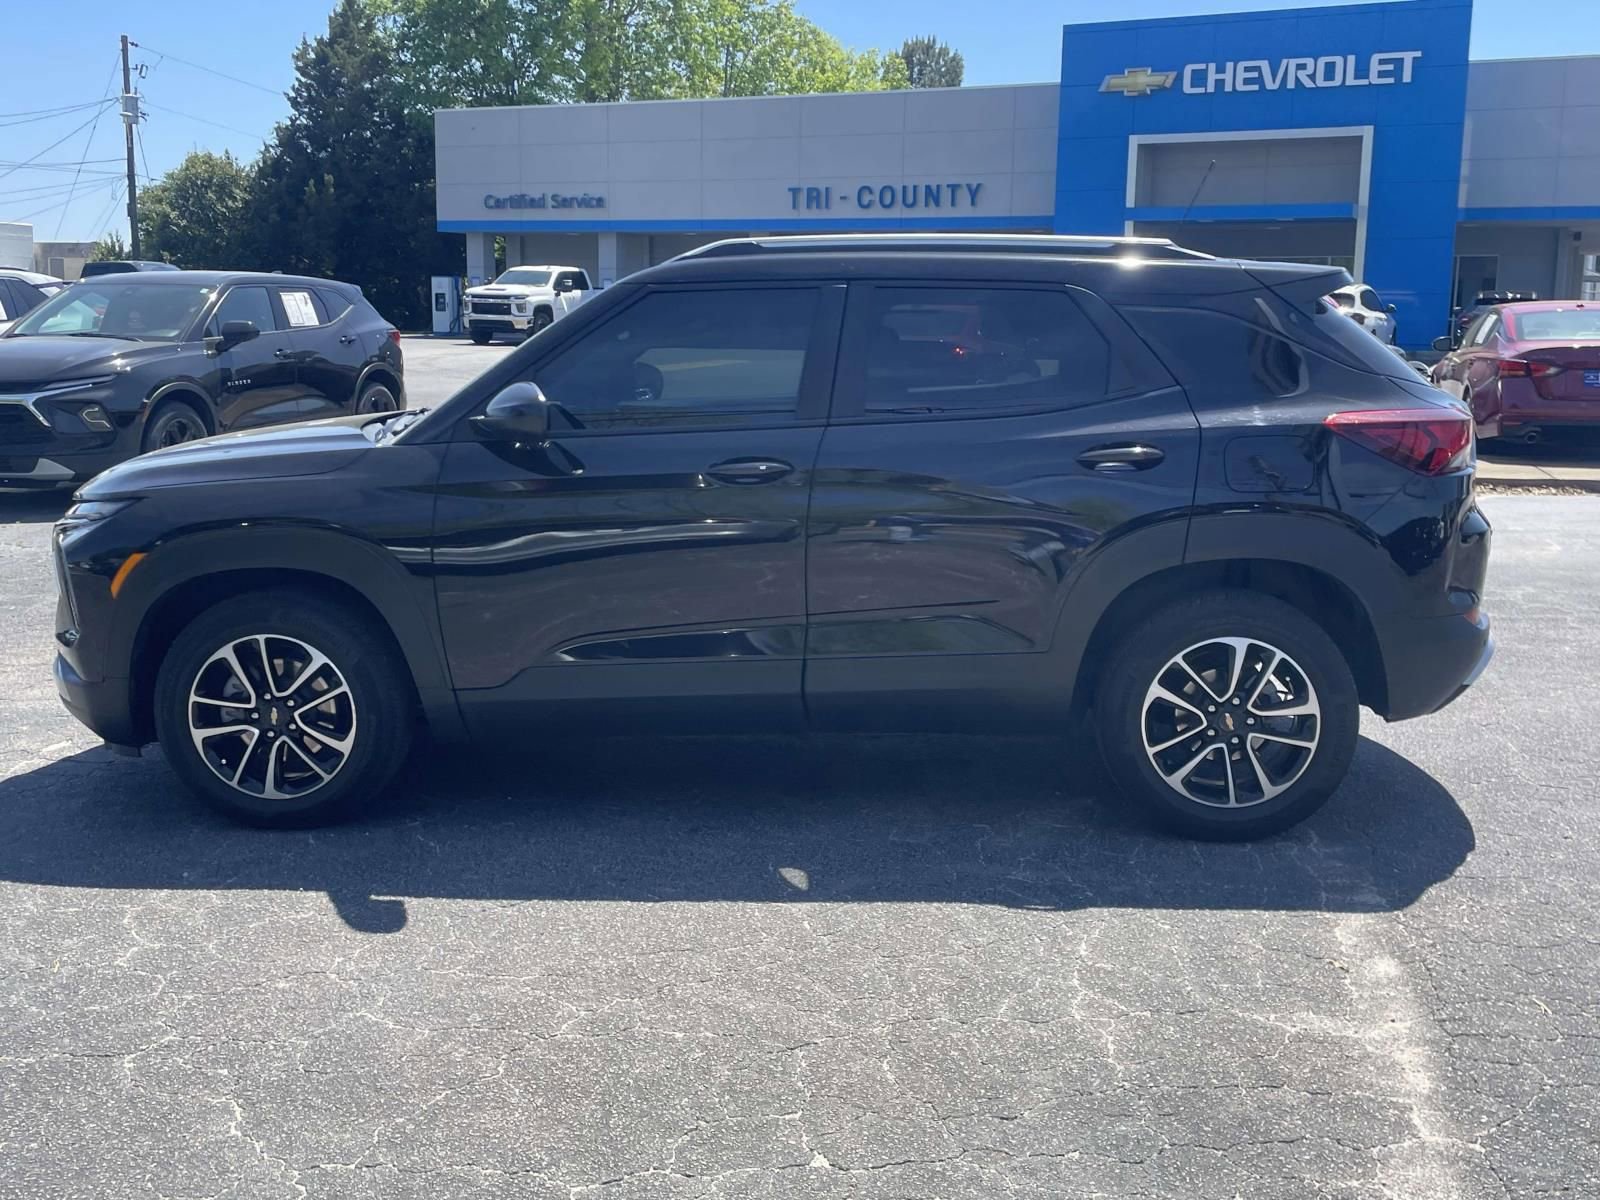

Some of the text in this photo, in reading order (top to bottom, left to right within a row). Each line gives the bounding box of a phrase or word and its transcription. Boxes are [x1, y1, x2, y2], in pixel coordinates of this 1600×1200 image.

[1183, 50, 1422, 94] CHEVROLET
[484, 193, 606, 209] Certified Service
